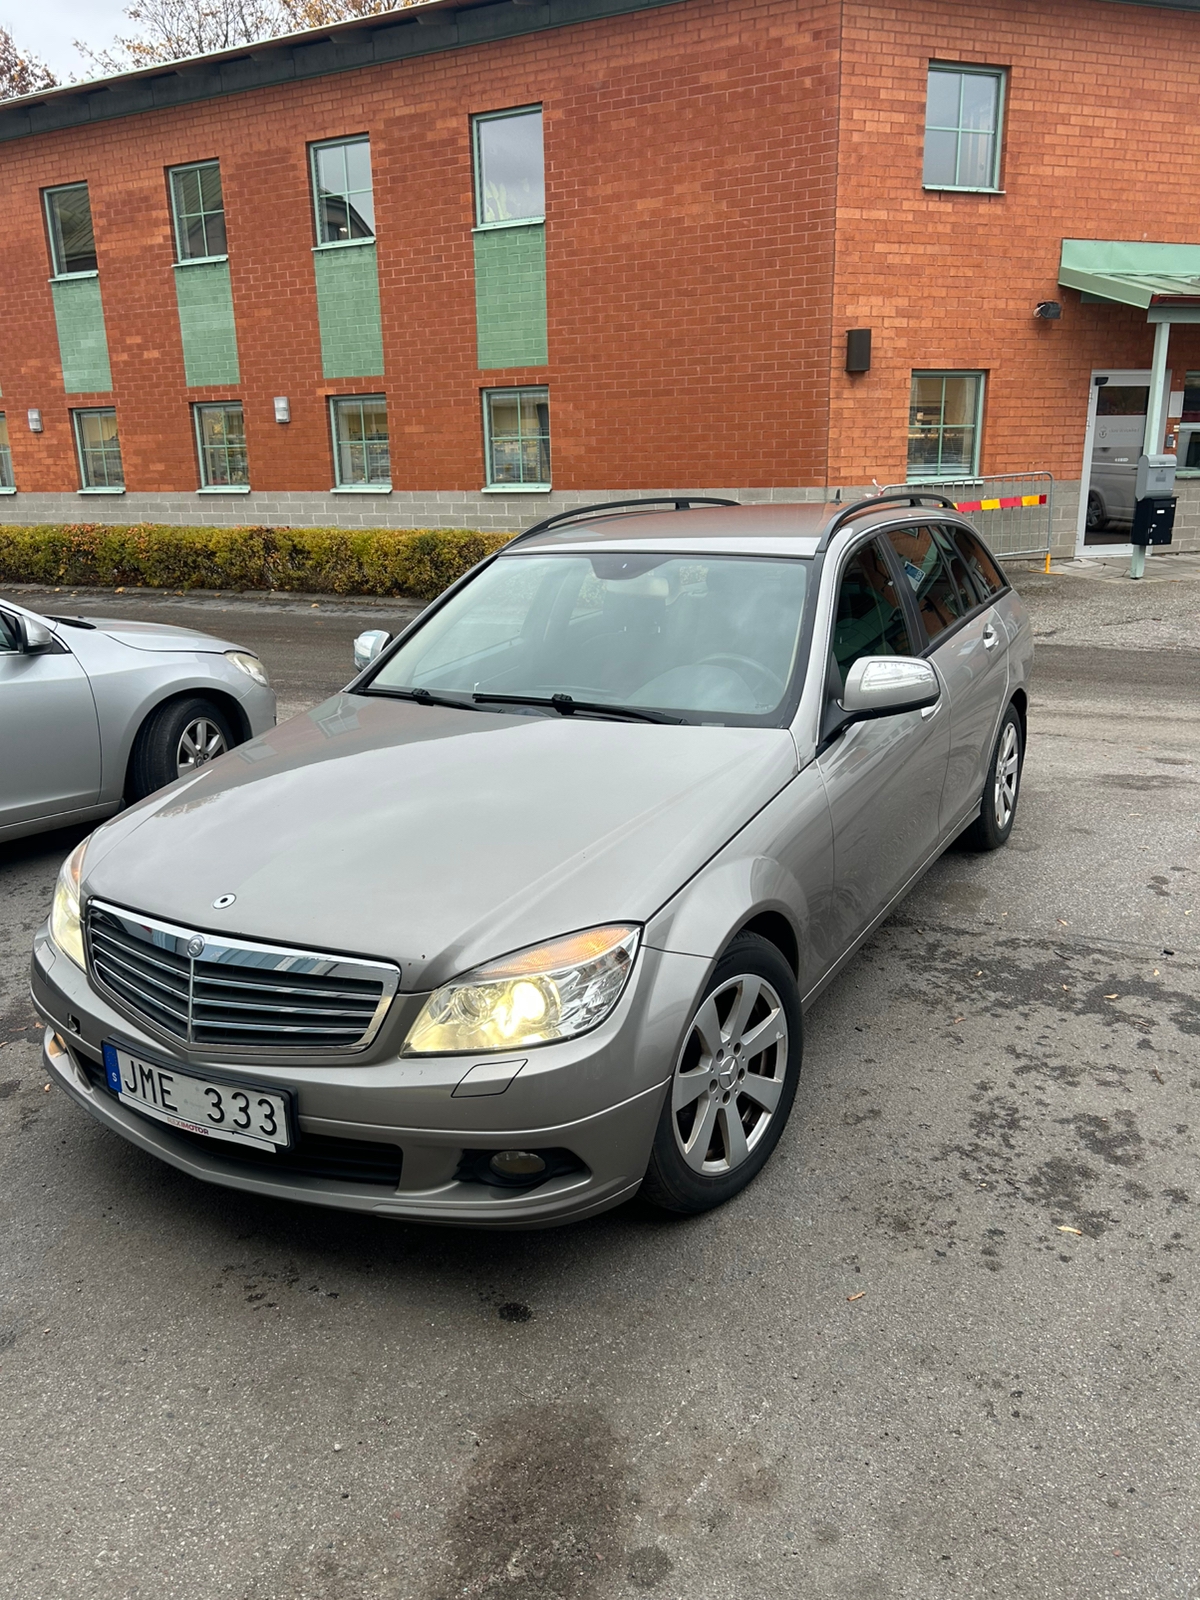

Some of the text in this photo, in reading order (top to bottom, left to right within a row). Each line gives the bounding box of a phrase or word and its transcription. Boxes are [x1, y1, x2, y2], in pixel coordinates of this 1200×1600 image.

[111, 1072, 118, 1082] S
[125, 1060, 278, 1136] JME 333
